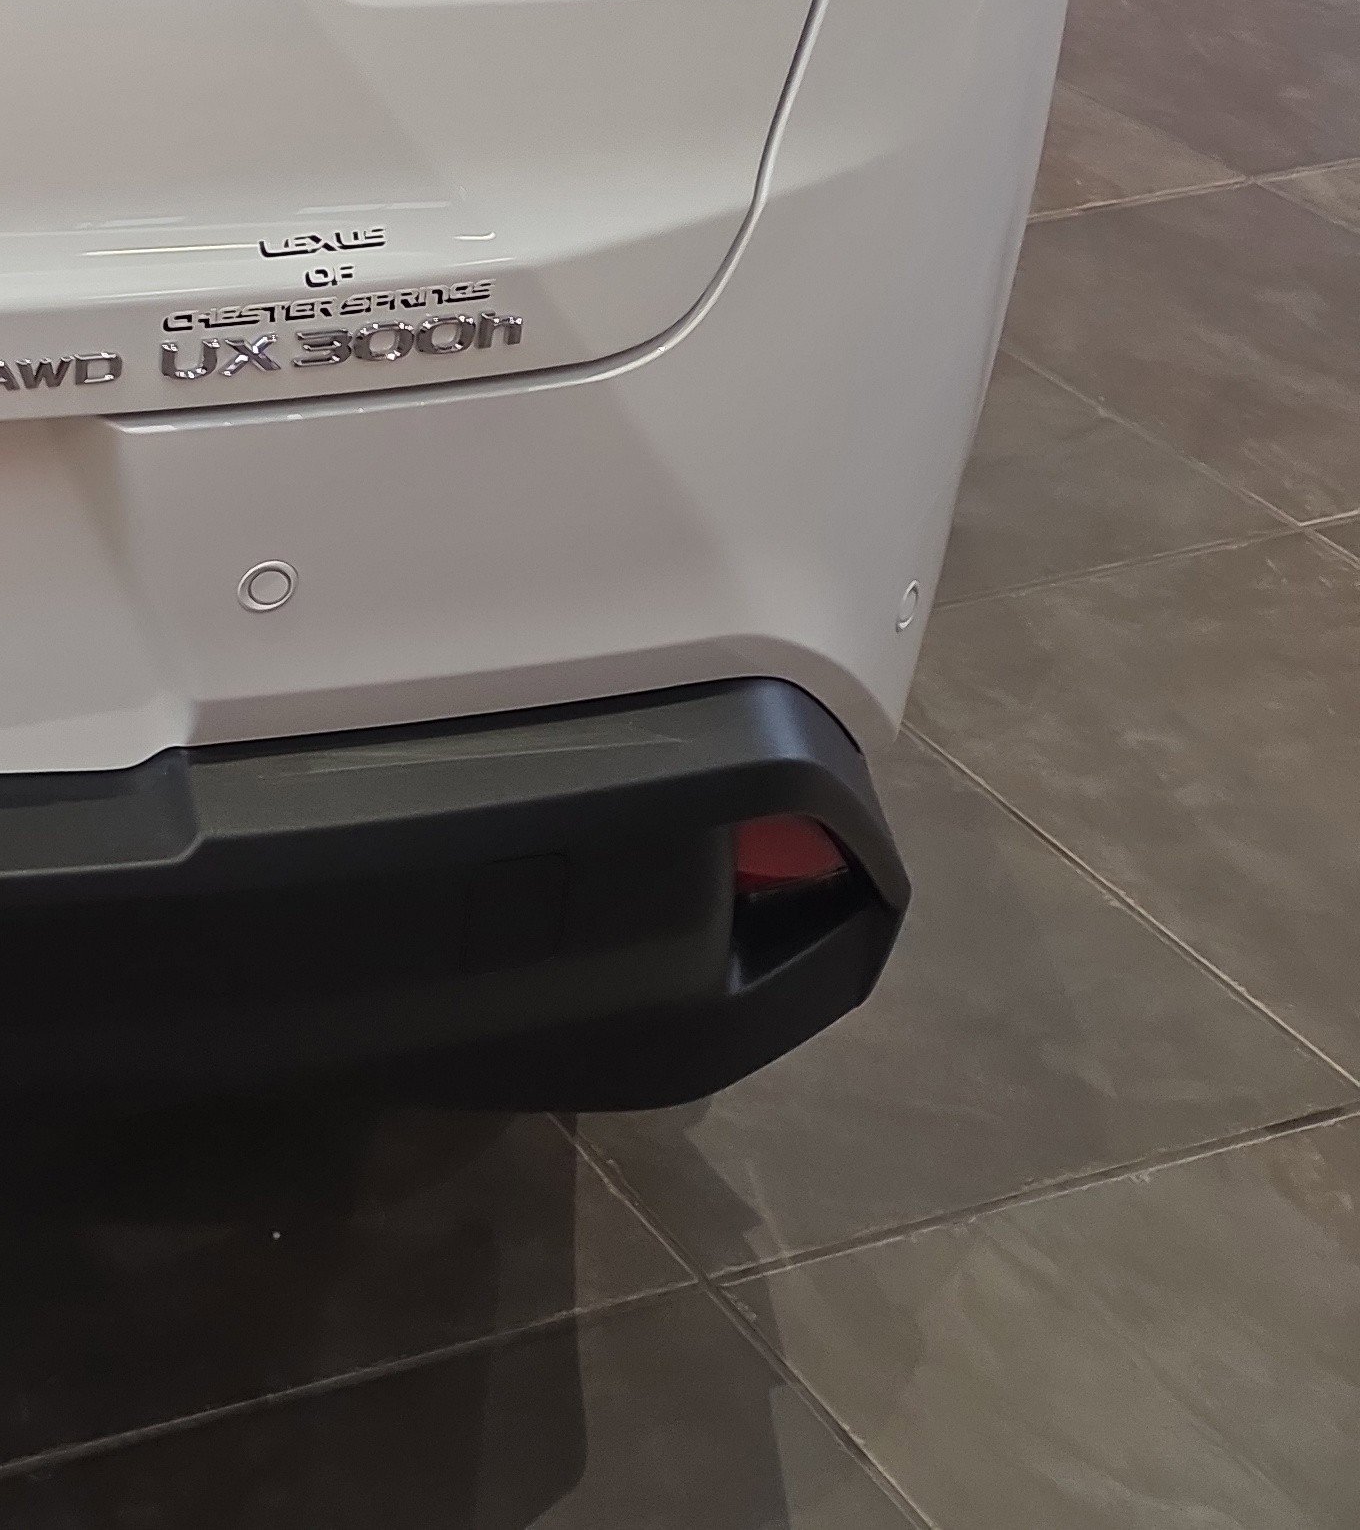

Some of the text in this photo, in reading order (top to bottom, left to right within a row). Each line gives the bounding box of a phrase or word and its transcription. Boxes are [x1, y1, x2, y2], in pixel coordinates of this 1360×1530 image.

[257, 226, 387, 260] LEXUS
[305, 265, 355, 289] OF
[161, 278, 497, 332] CHESTER SPRINGS
